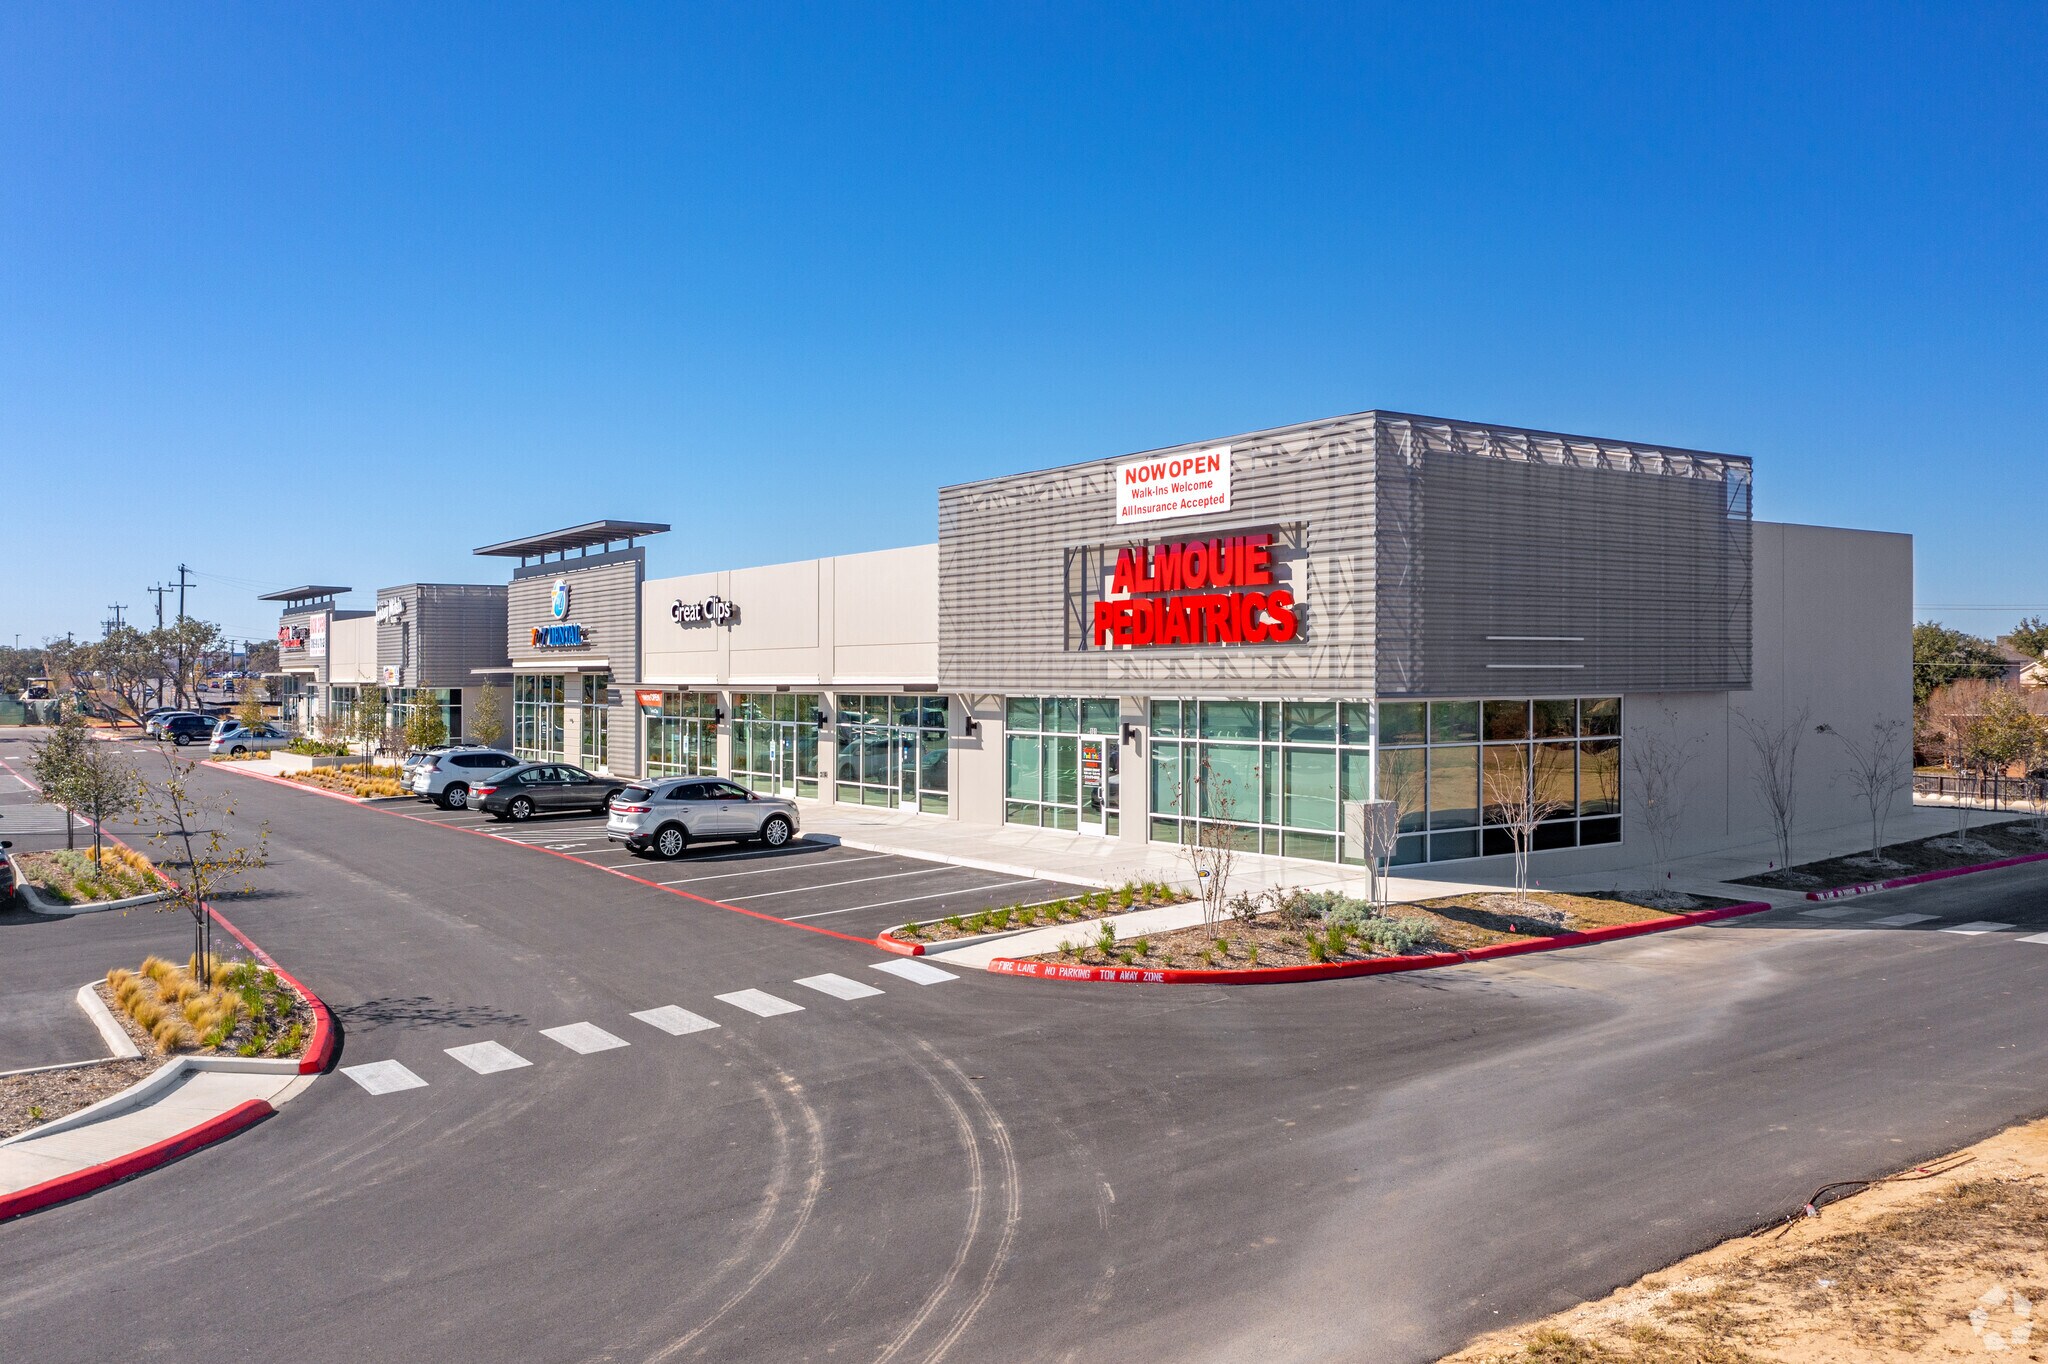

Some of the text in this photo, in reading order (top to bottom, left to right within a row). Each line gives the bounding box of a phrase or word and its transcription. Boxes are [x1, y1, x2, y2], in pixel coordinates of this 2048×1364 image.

[1125, 453, 1221, 485] NOW OPEN
[1131, 479, 1213, 499] Walk-Ins Welcome
[1121, 492, 1225, 517] All Insurance Accepted
[1110, 533, 1273, 595] ALMOUIE
[670, 597, 731, 624] Great Clips
[1094, 589, 1299, 646] PEDIATRICS
[998, 961, 1165, 982] FIRE LANE NO PARKING TOW AWAY ZONE
